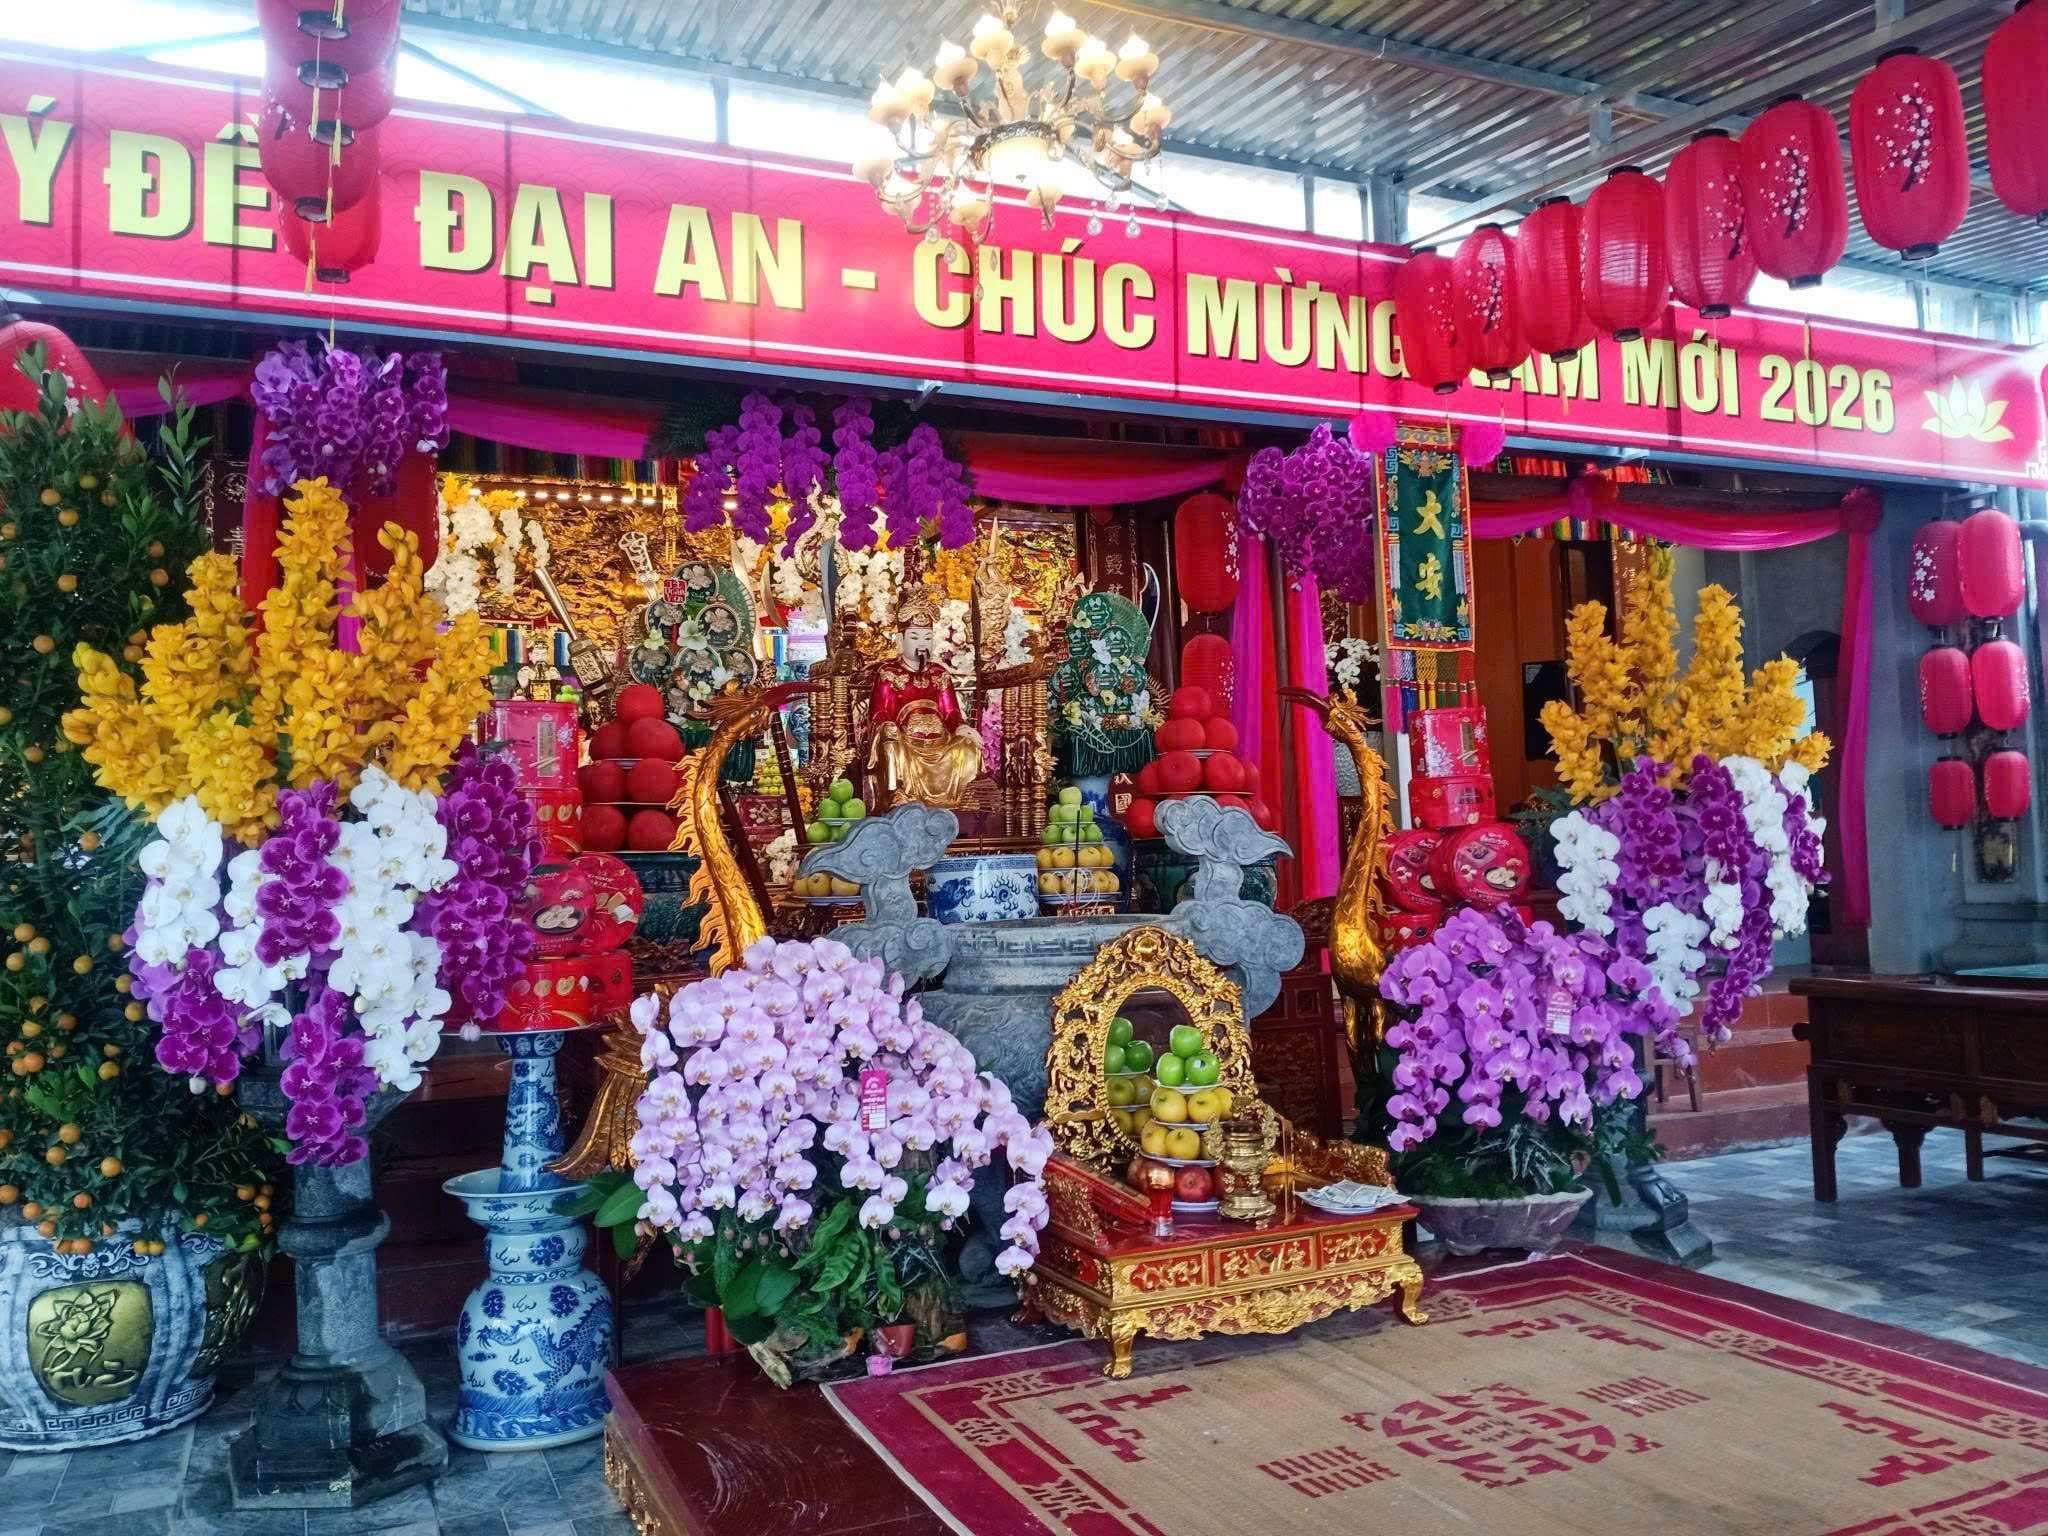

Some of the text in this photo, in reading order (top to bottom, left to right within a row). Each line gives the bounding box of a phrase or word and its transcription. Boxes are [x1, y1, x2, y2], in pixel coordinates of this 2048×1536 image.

[0, 94, 74, 226] Ý
[103, 112, 277, 251] ĐỀ
[414, 170, 614, 305] ĐẠI
[653, 202, 806, 311] AN
[842, 268, 878, 292] -
[912, 237, 1158, 350] CHÚC
[1186, 266, 1411, 380] MỪNG
[1621, 328, 1741, 418] MỚI
[1759, 354, 1897, 435] 2026
